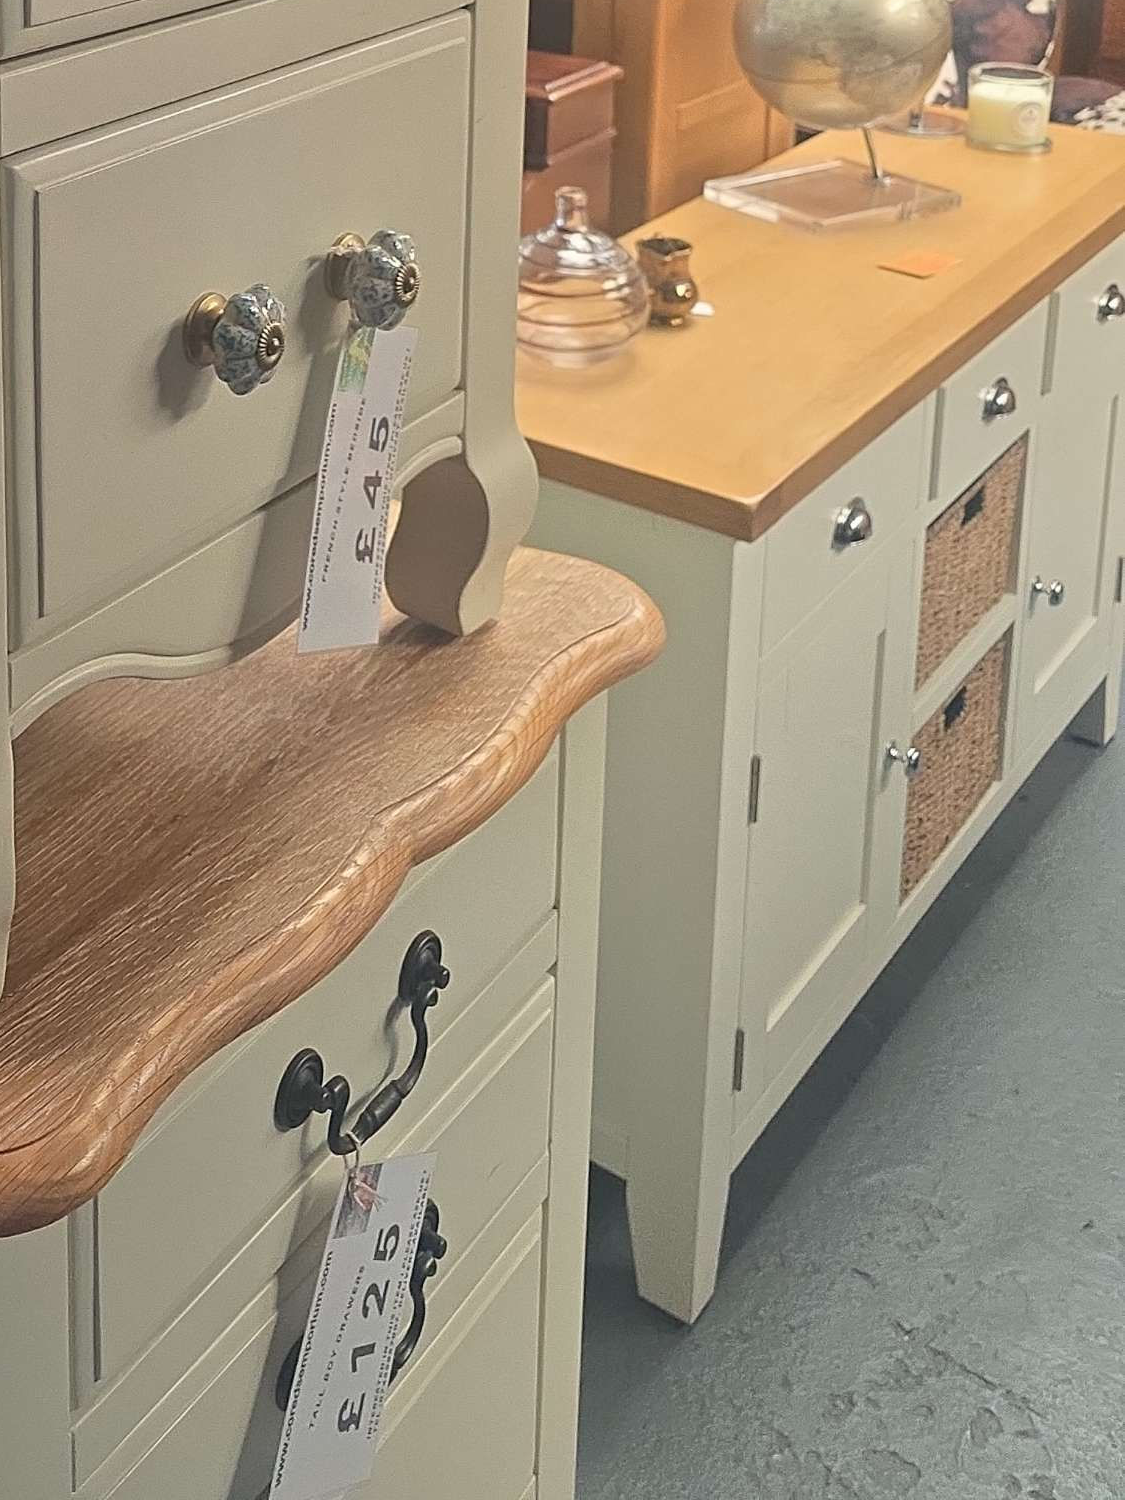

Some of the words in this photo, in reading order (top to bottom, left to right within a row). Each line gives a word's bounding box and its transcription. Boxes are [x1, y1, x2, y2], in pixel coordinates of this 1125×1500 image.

[308, 1388, 325, 1430] TALL
[323, 1349, 337, 1382] BOY
[335, 1265, 365, 1343] DRAWERS
